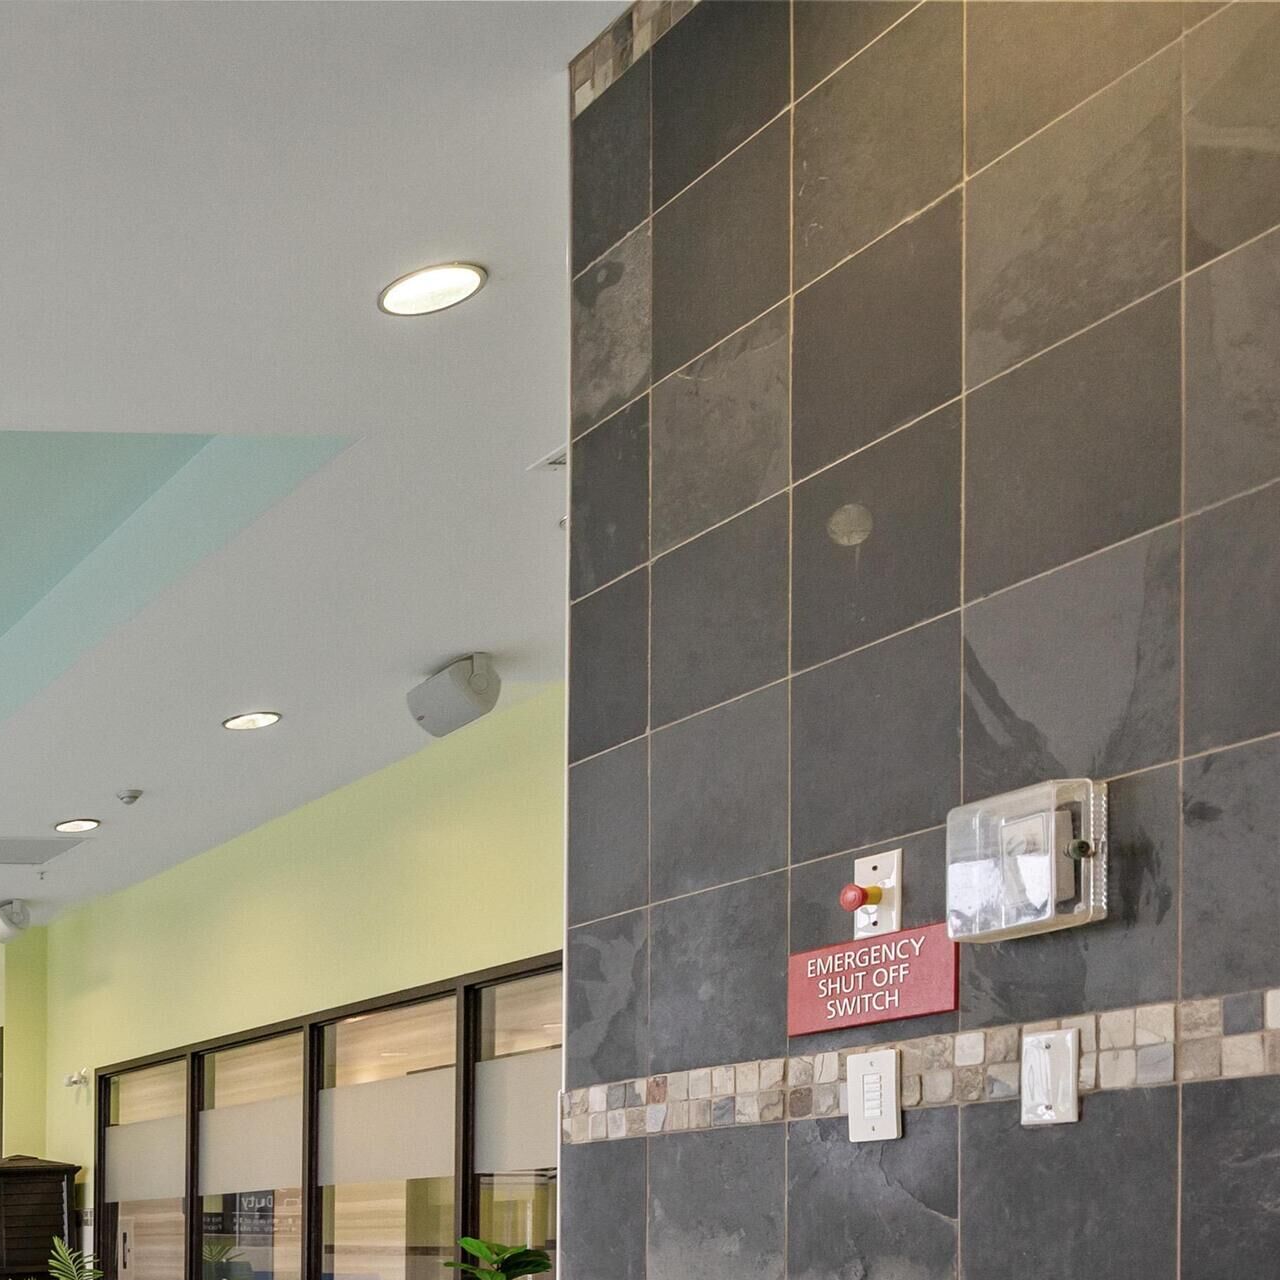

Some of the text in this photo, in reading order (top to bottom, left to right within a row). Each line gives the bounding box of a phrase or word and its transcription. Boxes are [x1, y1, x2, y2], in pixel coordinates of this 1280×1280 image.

[807, 936, 926, 978] EMERGENCY
[818, 963, 910, 998] SHUT OFF
[826, 989, 900, 1019] SWITCH
